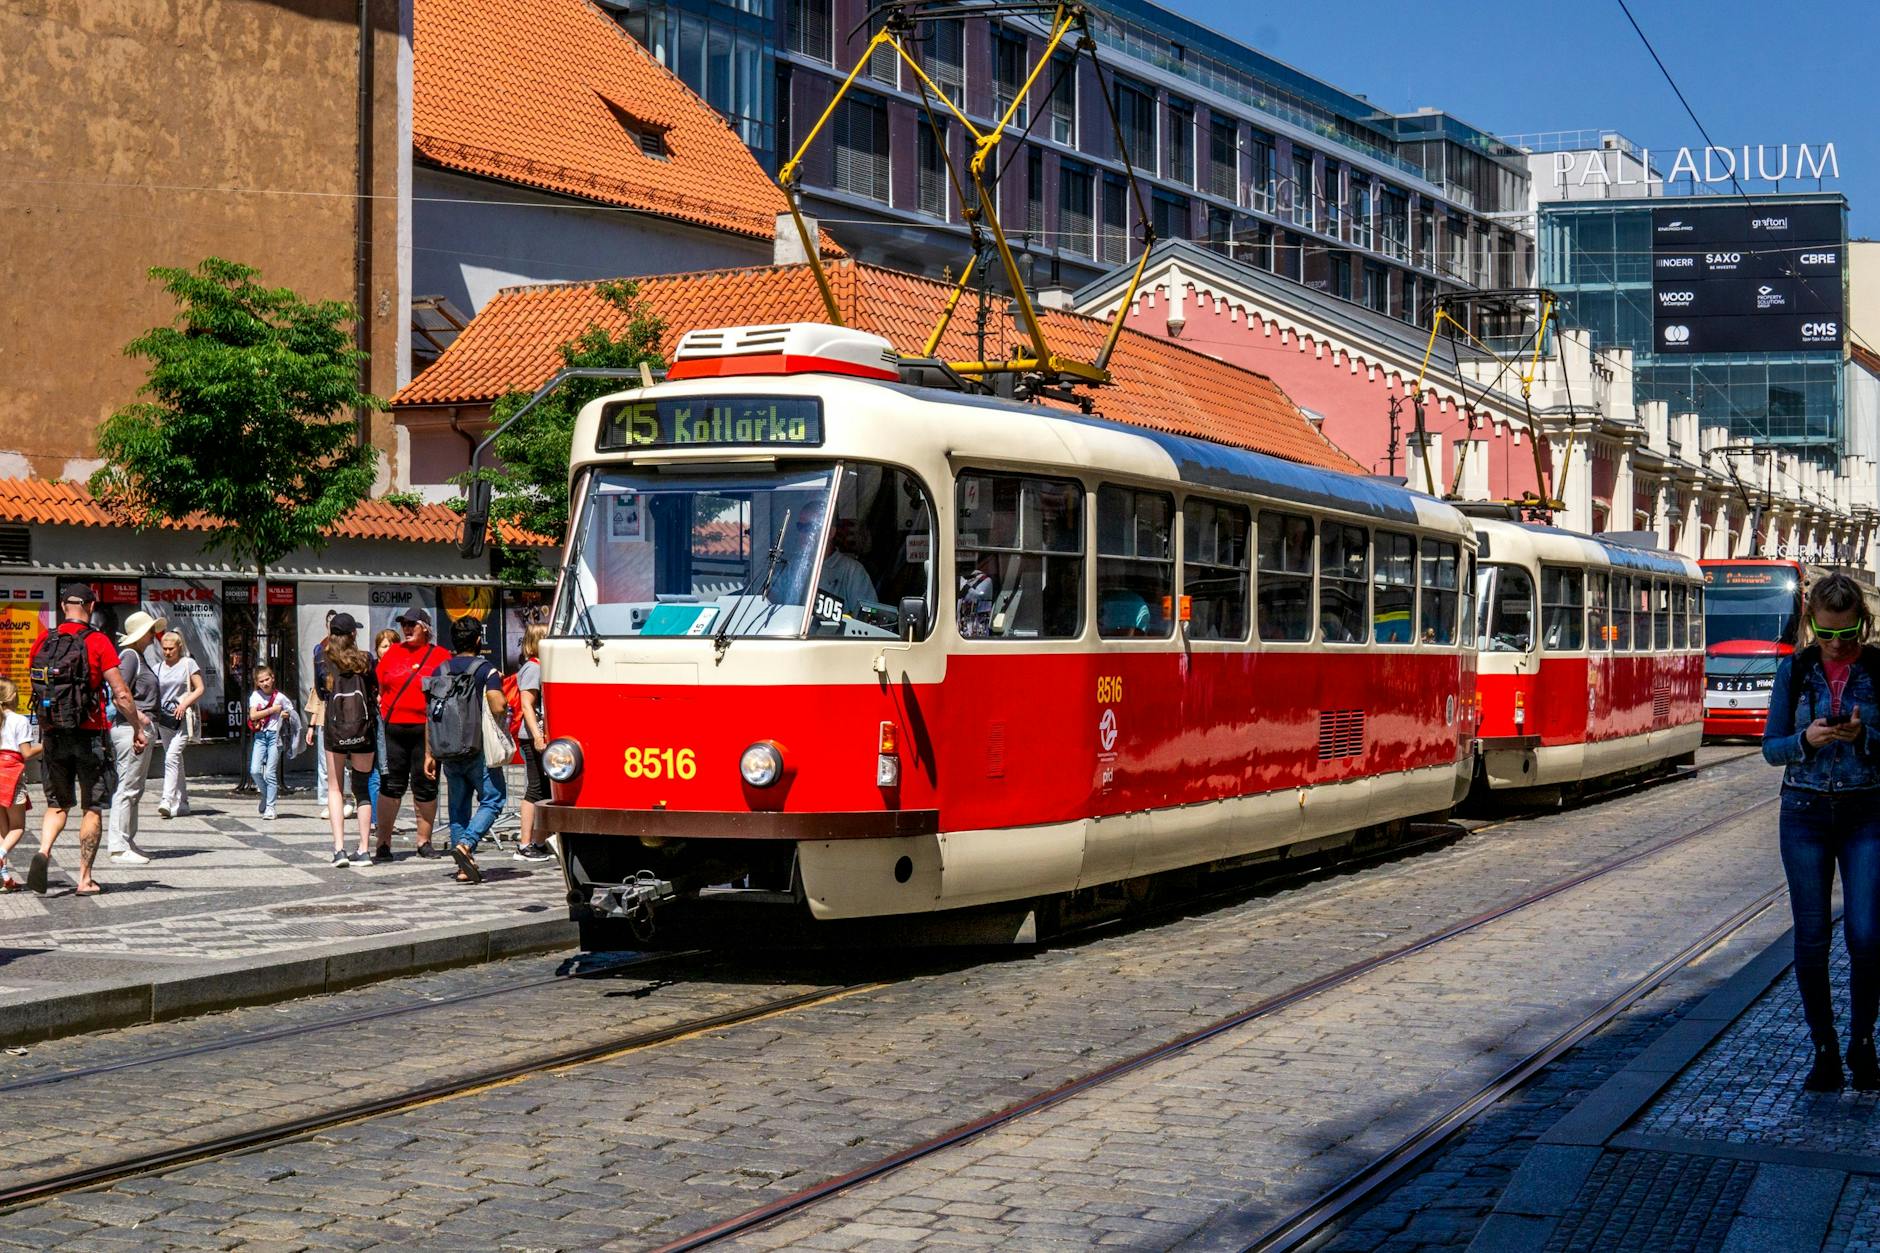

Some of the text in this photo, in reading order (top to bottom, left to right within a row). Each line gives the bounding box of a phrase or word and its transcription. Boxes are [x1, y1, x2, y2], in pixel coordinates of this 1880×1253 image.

[1553, 142, 1839, 188] PALLADIUM
[1663, 258, 1693, 267] NOERR
[1705, 253, 1741, 264] SAXO
[1800, 253, 1836, 264] CBRE
[1659, 292, 1694, 302] WOOD
[1801, 322, 1837, 336] CMS
[615, 403, 805, 445] 15 Kotlářka
[173, 604, 214, 612] EXHIBITION
[0, 618, 31, 631] olours
[1097, 676, 1123, 703] 8516
[338, 736, 366, 746] adidas
[624, 746, 697, 780] 8516
